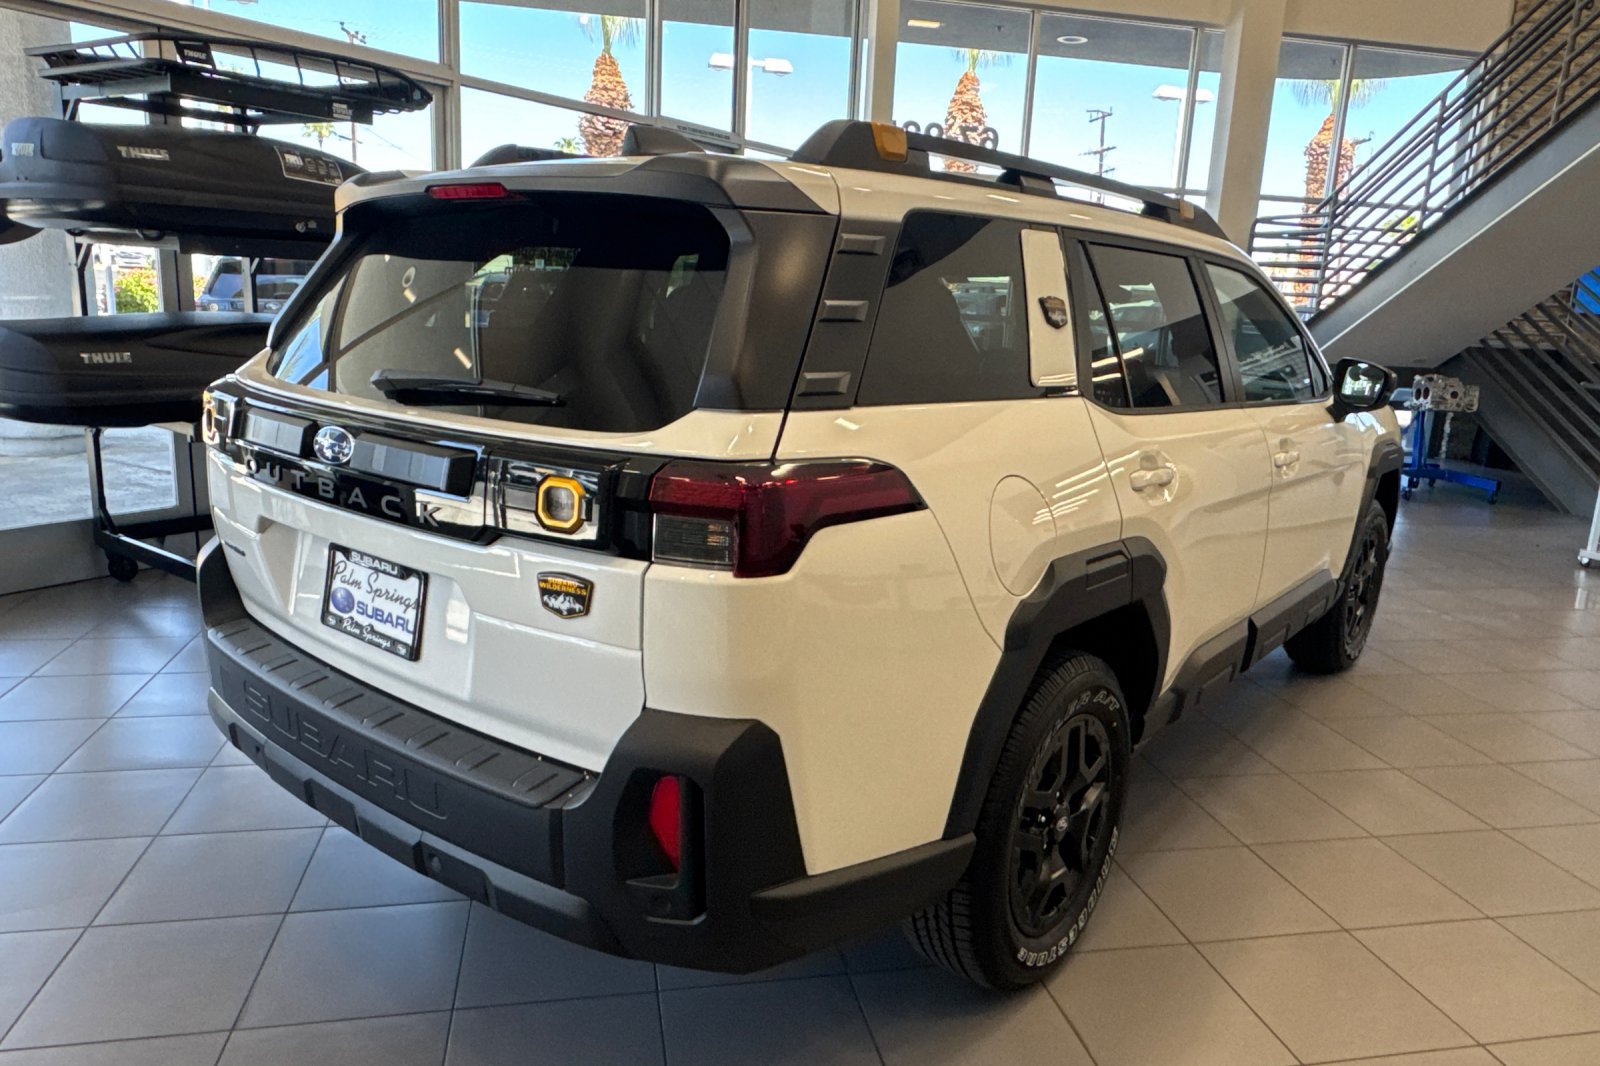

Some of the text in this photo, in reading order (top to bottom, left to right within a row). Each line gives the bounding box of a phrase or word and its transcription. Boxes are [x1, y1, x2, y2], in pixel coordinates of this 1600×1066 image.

[183, 49, 207, 60] THULE
[116, 145, 170, 161] THULE
[79, 351, 132, 364] THULE
[244, 456, 442, 528] OUTBACK
[348, 550, 399, 575] SUBARU
[333, 560, 419, 614] Palm Springs
[539, 581, 588, 595] WILDERNESS
[342, 618, 392, 649] Palm Springs
[243, 679, 449, 821] SUBARU
